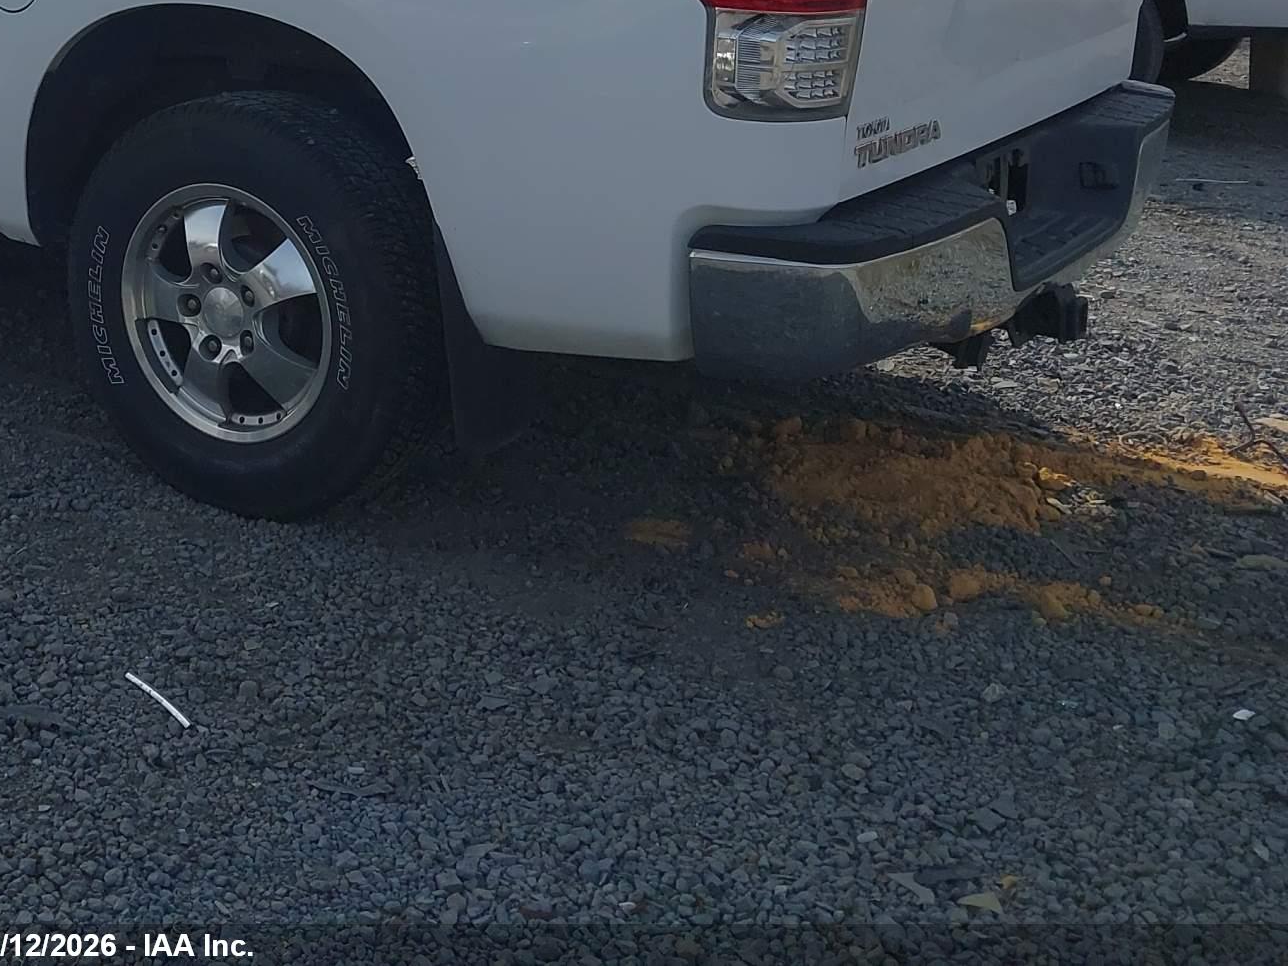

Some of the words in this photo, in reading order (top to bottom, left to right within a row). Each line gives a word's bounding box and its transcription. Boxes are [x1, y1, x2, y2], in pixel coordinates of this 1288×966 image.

[854, 120, 942, 168] TUNDRA
[87, 225, 124, 385] MICHELIN
[296, 215, 354, 390] MICHELIN
